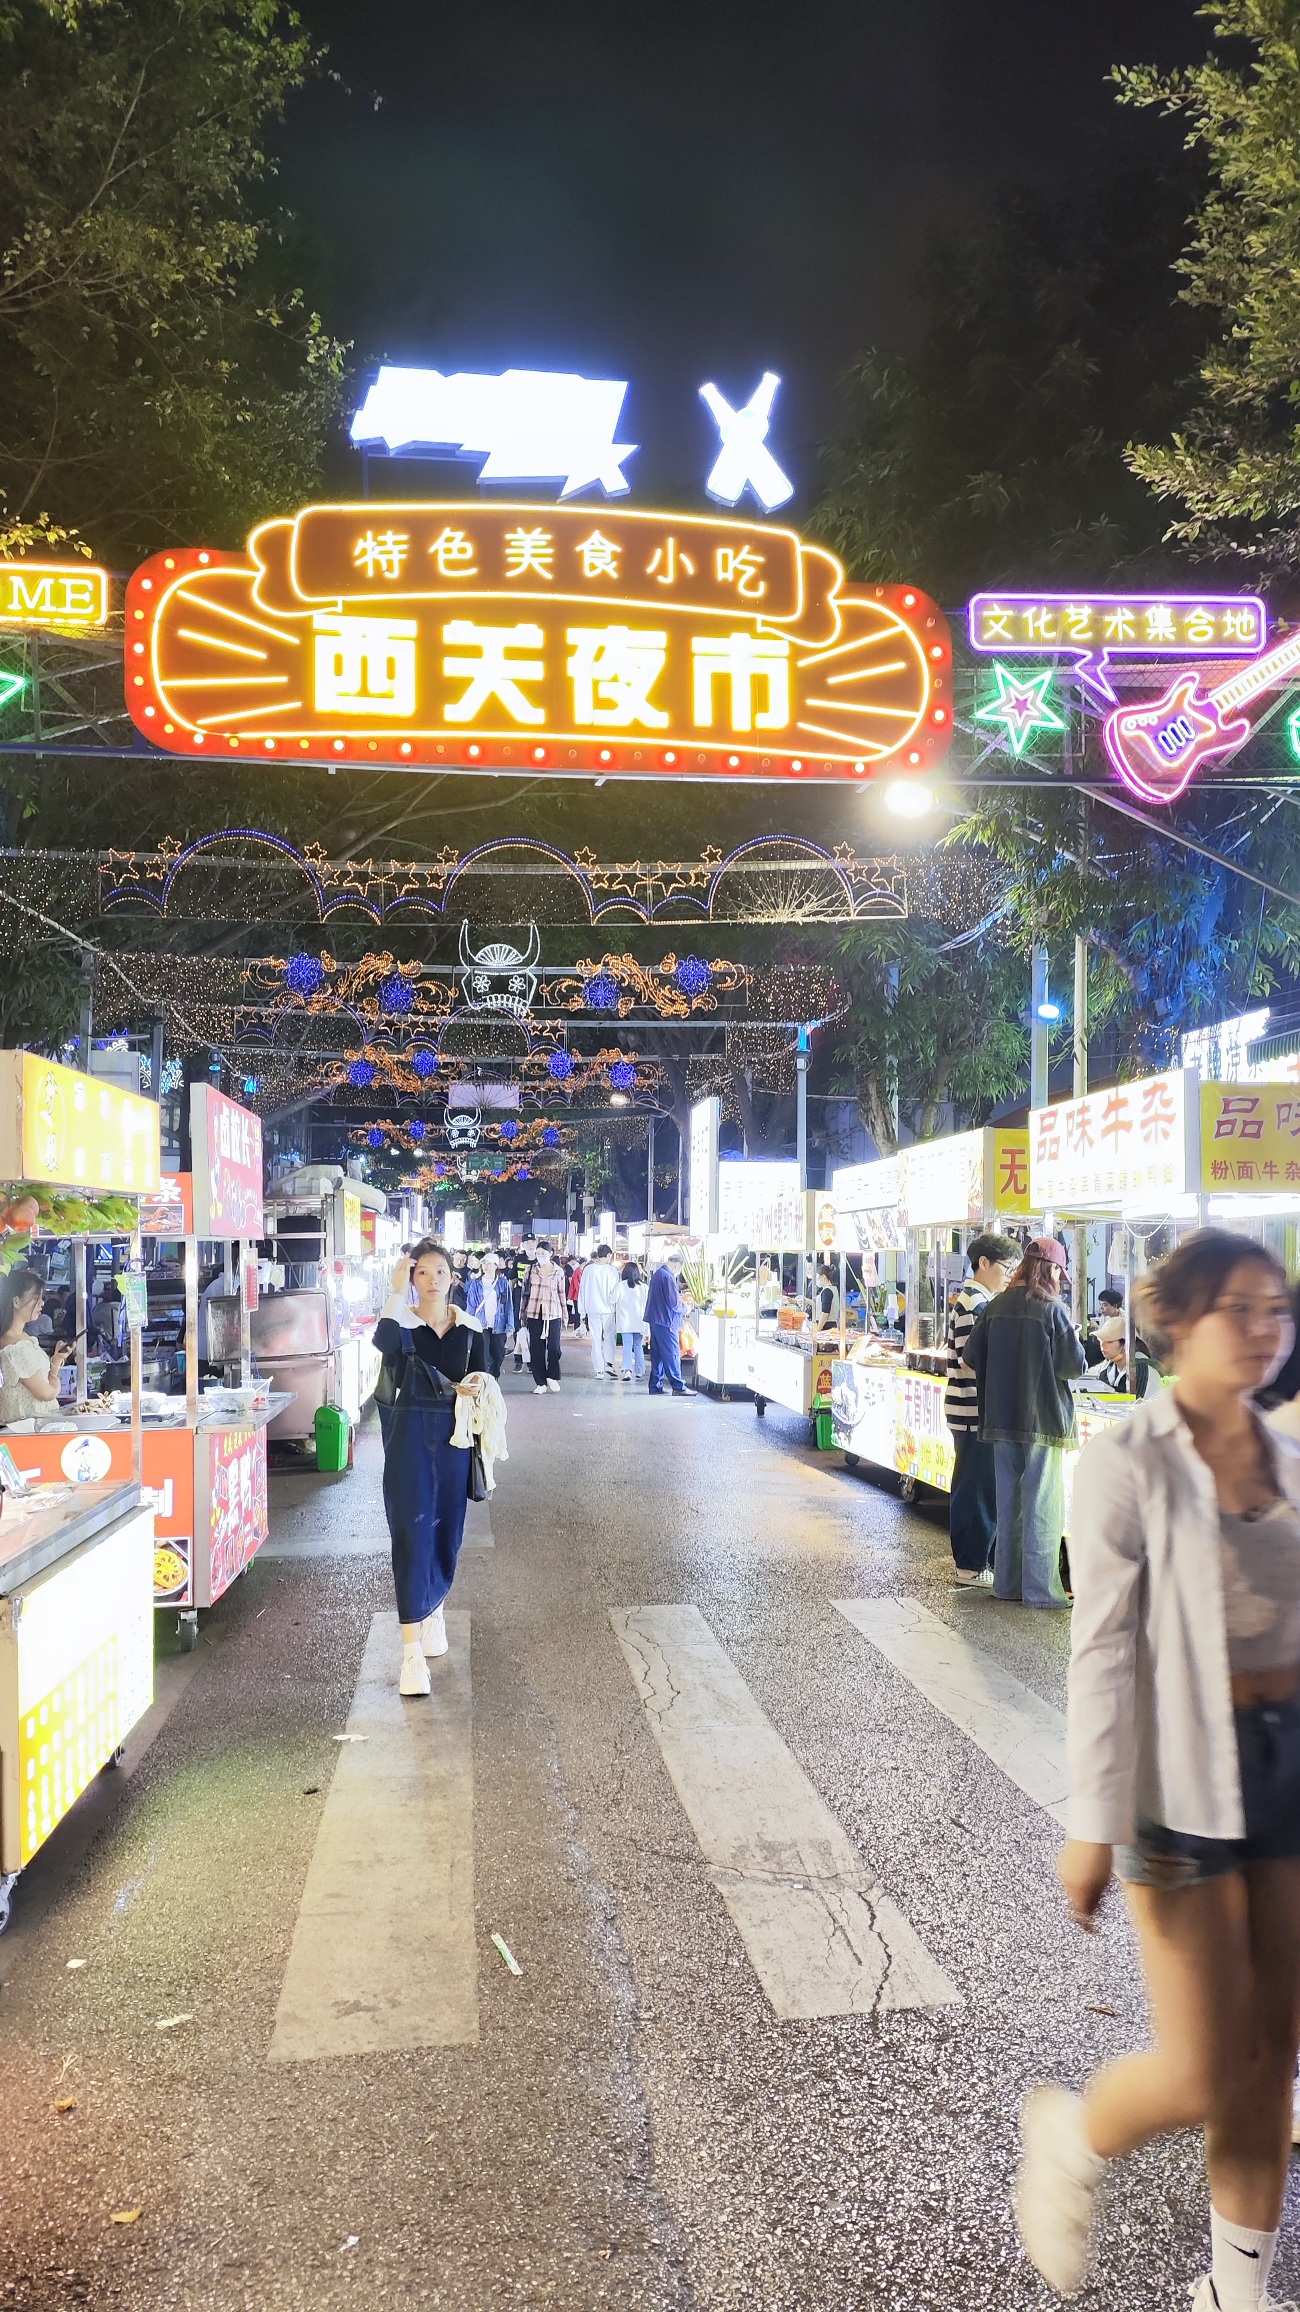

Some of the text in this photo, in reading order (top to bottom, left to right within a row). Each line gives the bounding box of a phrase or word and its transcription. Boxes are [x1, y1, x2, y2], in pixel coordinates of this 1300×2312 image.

[354, 526, 767, 600] 特色美食小吃
[982, 603, 1258, 642] 文化艺术集合地
[311, 612, 791, 733] 西关夜市
[1037, 1081, 1177, 1164] 品味牛杂
[1000, 1148, 1028, 1195] 无
